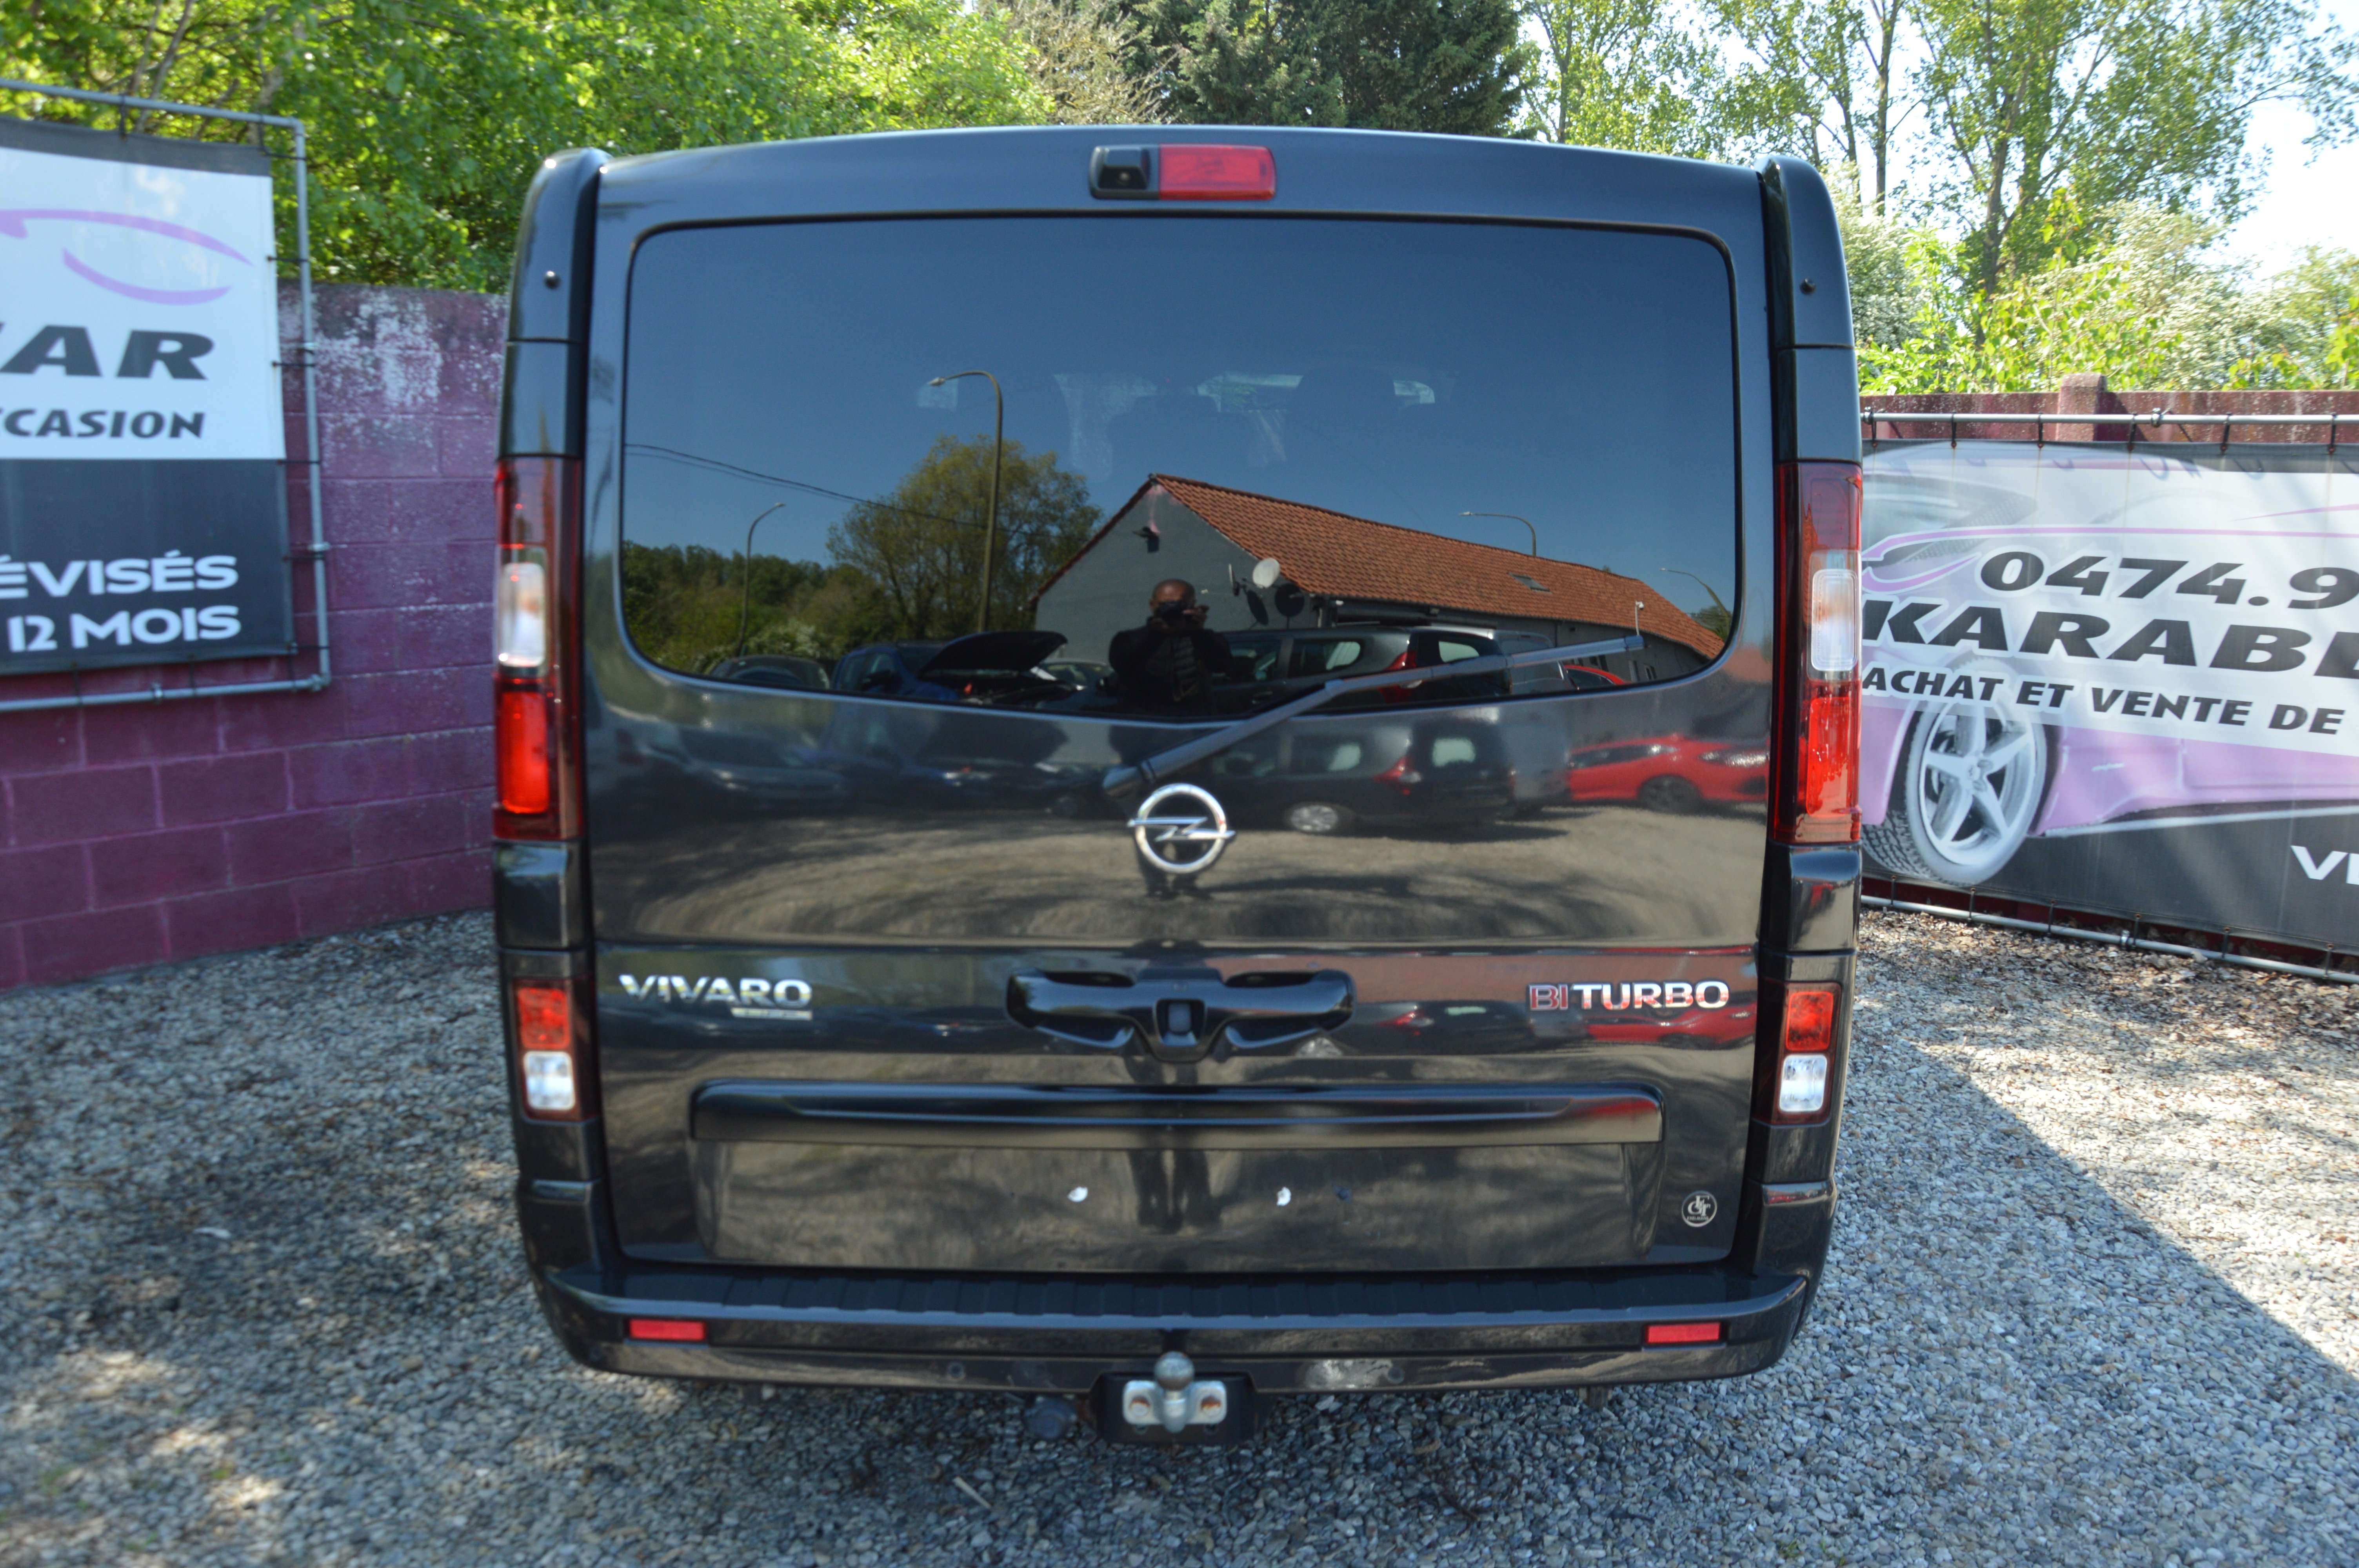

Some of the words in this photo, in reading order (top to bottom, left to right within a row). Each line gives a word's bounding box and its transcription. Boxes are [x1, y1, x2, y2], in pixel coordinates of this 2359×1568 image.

[0, 321, 215, 380] AR
[0, 408, 205, 439] CASION
[1981, 551, 2359, 610] 0474.9
[7, 615, 58, 653] 12
[70, 605, 241, 649] MOIS
[1863, 667, 2004, 701] ACHAT
[2016, 681, 2074, 708] ET
[2092, 687, 2253, 726] VENTE
[2268, 704, 2346, 735] DE
[619, 974, 812, 1008] VIVARO
